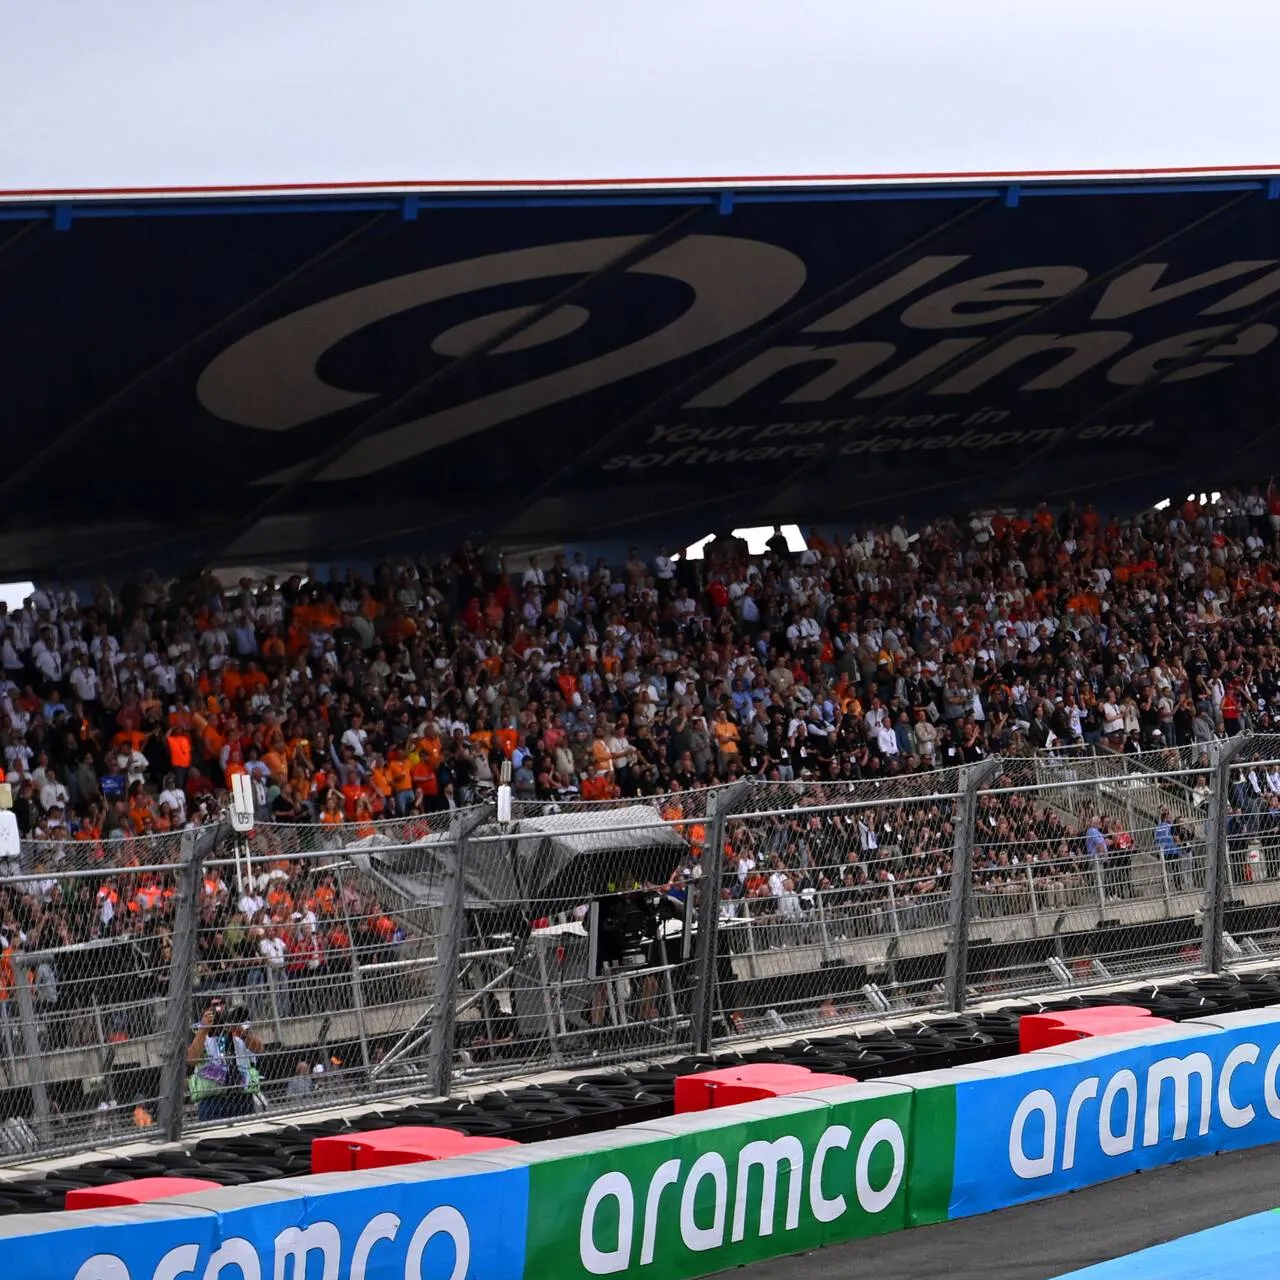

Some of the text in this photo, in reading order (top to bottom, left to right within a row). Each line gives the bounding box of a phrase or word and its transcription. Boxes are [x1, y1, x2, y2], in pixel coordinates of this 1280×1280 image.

[681, 324, 1279, 409] nine
[603, 419, 1153, 470] software development
[645, 405, 1010, 445] Your partner in
[580, 1118, 905, 1275] aramco
